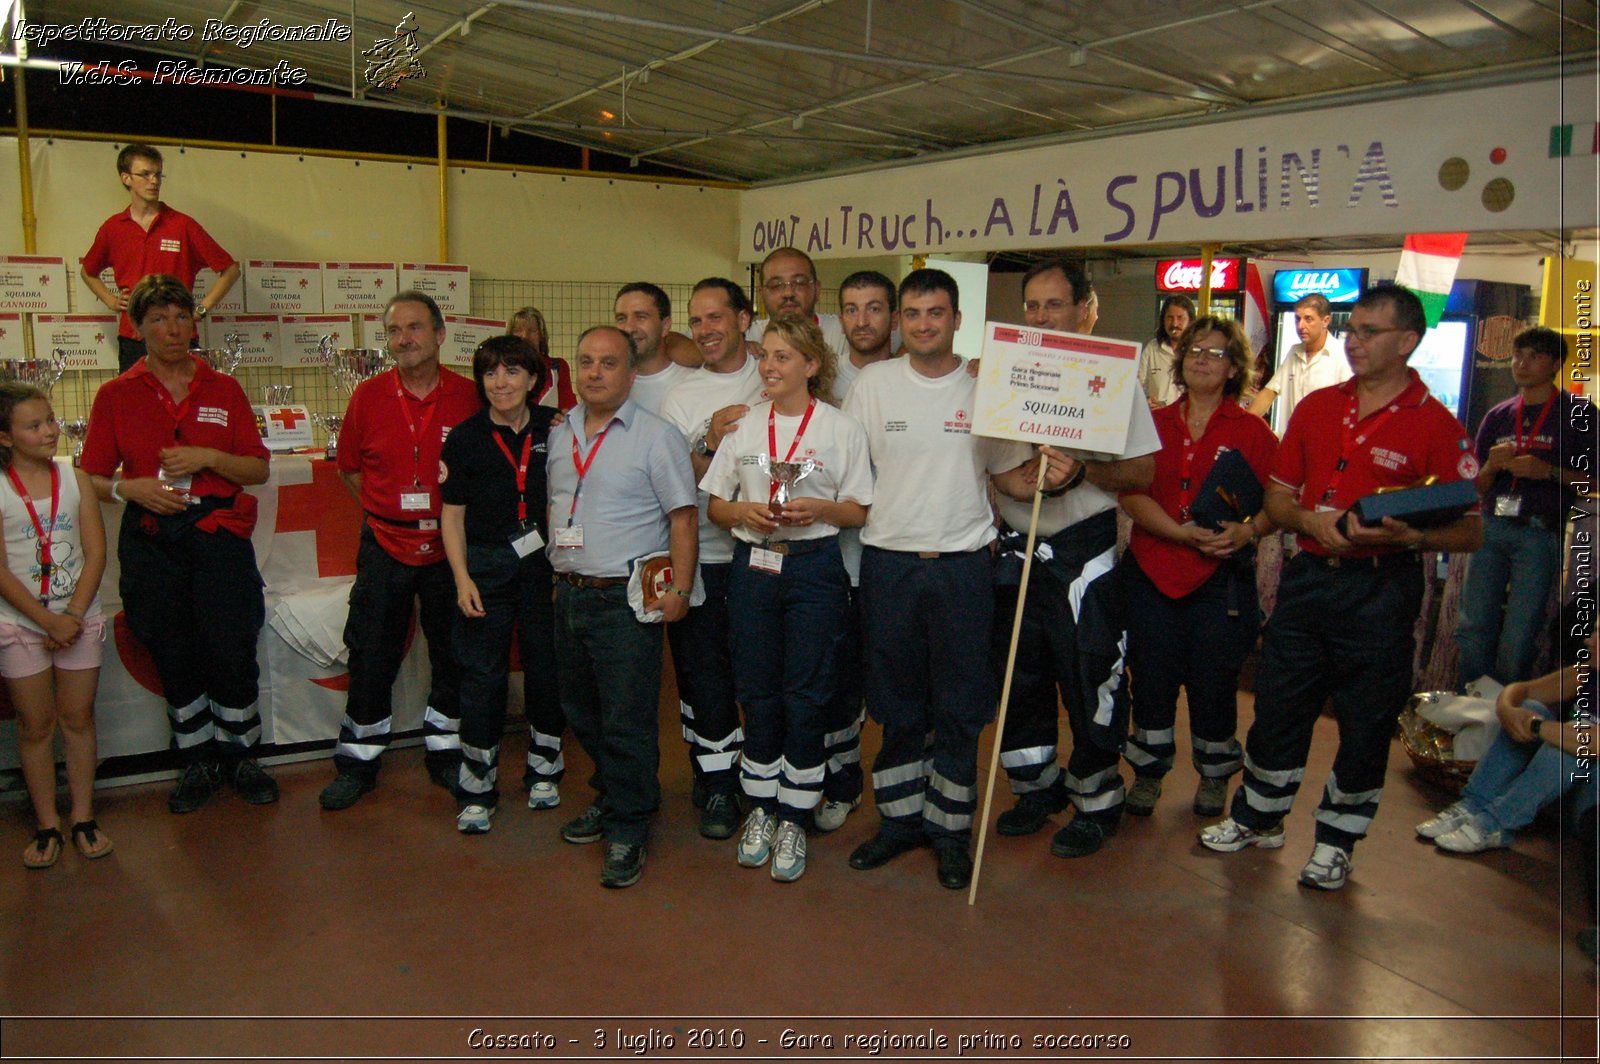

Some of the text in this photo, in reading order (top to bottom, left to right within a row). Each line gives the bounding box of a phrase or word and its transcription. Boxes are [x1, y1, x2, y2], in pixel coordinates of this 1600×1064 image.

[753, 214, 800, 253] QUAT
[807, 217, 832, 252] AL
[1291, 272, 1340, 289] LILIA
[5, 291, 42, 299] SQUADRA
[0, 301, 48, 309] CANNOBIO
[1030, 383, 1060, 392] Soccorso
[1022, 400, 1085, 419] SQUADRA
[1019, 421, 1083, 440] CALABRIA
